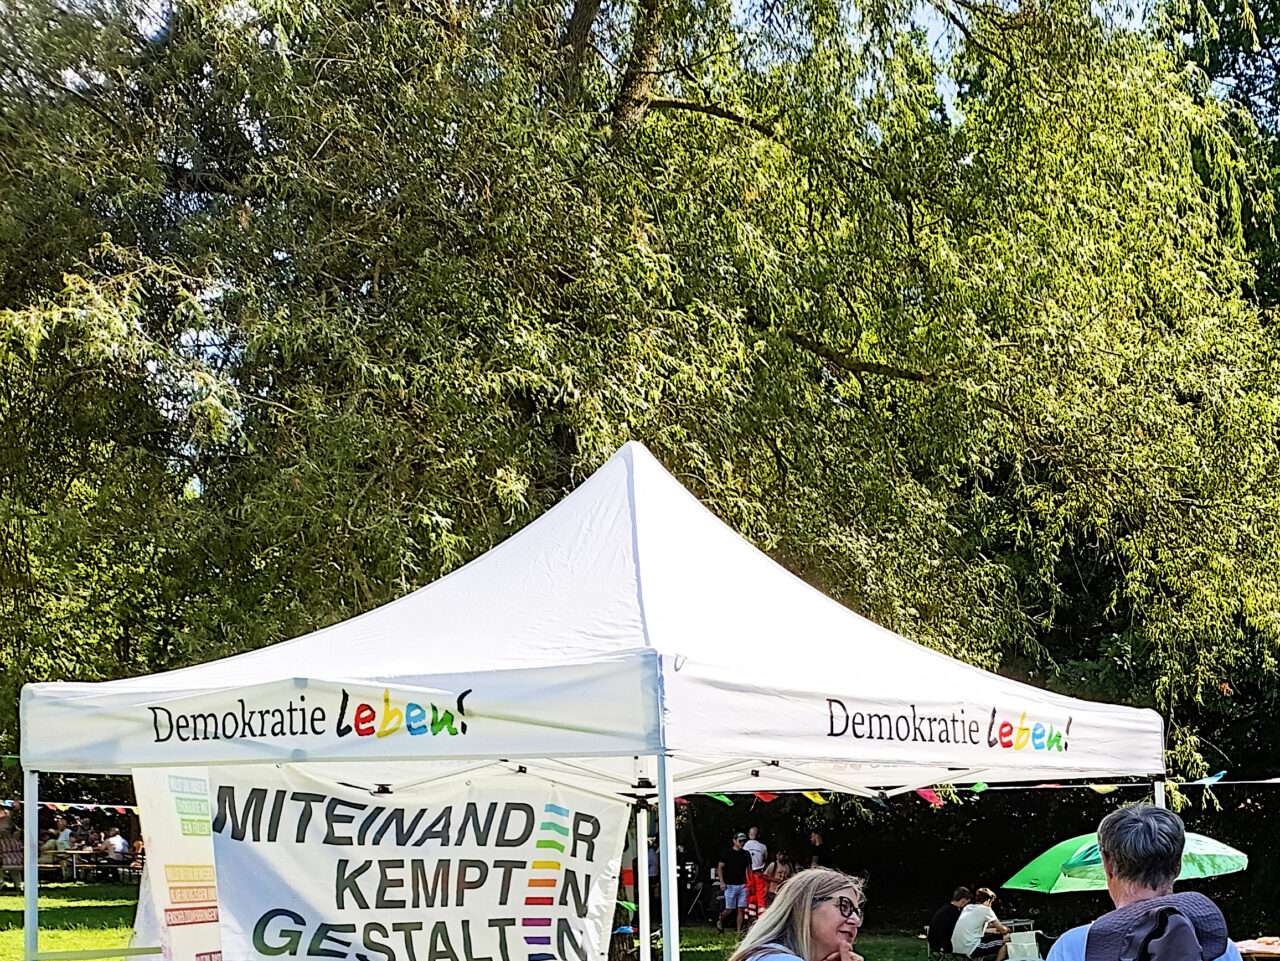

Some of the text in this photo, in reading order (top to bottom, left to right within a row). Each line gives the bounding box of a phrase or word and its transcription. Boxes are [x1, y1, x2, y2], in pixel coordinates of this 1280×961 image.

[147, 695, 326, 743] Demokratie
[826, 698, 980, 745] Demokratie
[212, 785, 601, 862] MITEINANDER
[335, 858, 592, 918] KEMPTEN
